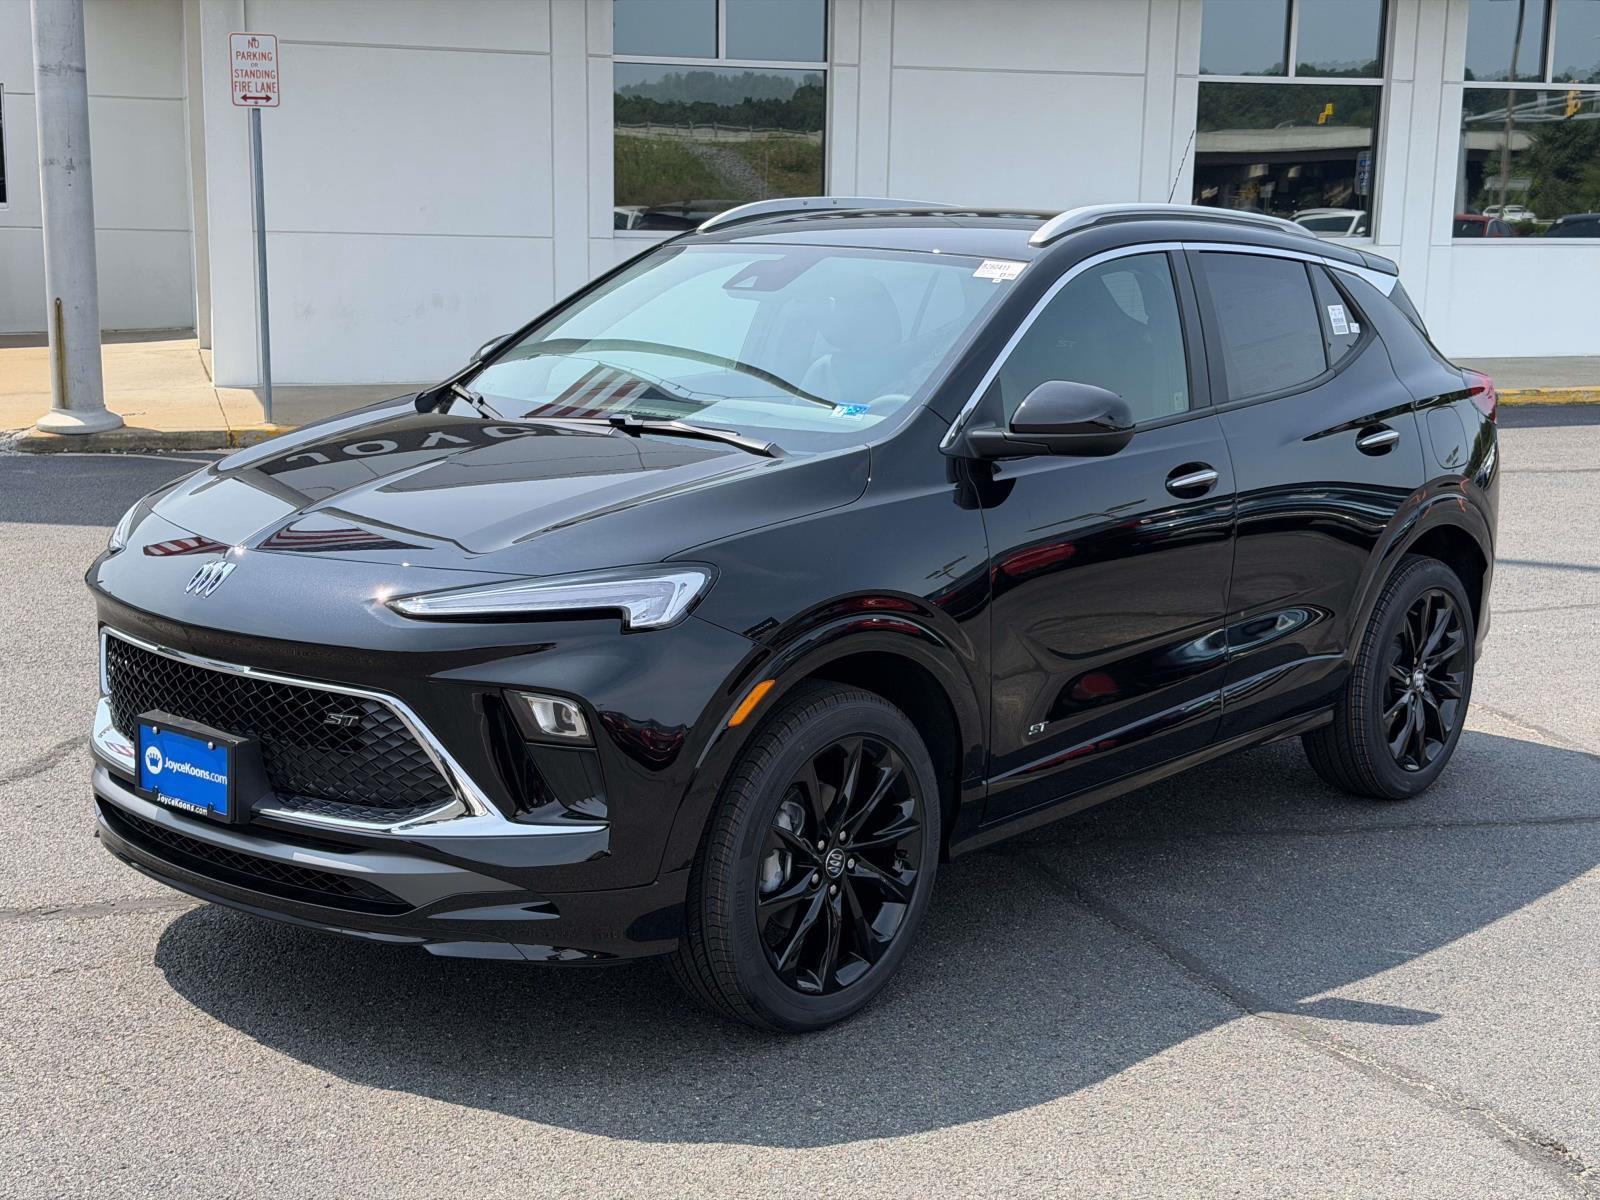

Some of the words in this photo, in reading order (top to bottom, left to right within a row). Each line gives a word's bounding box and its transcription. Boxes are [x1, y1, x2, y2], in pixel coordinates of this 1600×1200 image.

[248, 39, 259, 48] NO
[236, 51, 272, 61] PARKING
[234, 69, 275, 79] STANDING
[234, 81, 252, 93] FIRE
[255, 82, 277, 93] LANE
[323, 713, 359, 726] ST
[1028, 721, 1050, 736] ST
[164, 756, 228, 785] JoyceKoons.com
[156, 793, 208, 816] JoyceKoons.com
